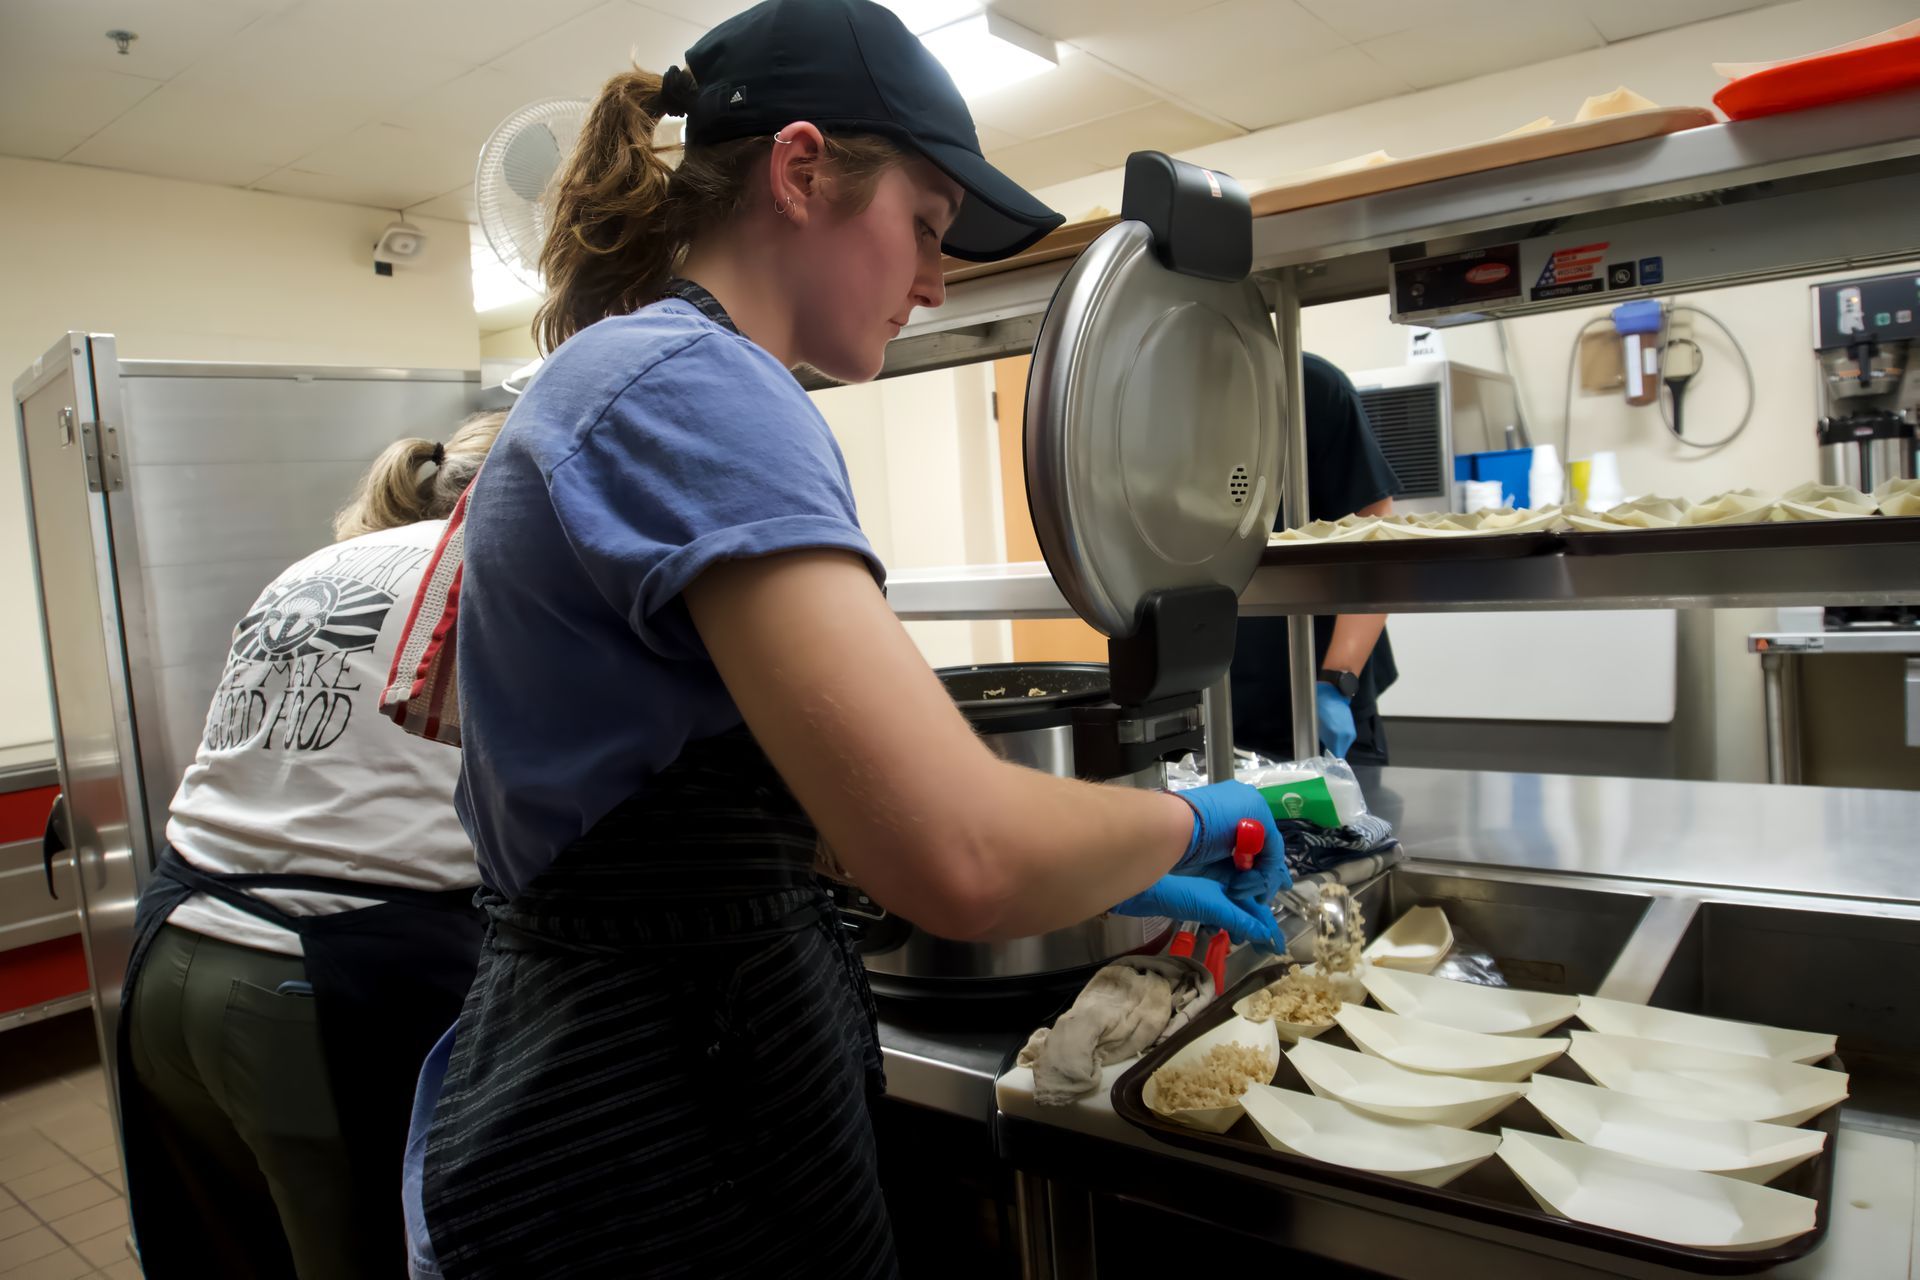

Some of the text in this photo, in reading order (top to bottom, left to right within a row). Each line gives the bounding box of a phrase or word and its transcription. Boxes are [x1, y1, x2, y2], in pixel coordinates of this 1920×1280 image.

[258, 646, 375, 692] MAKE
[207, 690, 352, 751] GOOD FOOD
